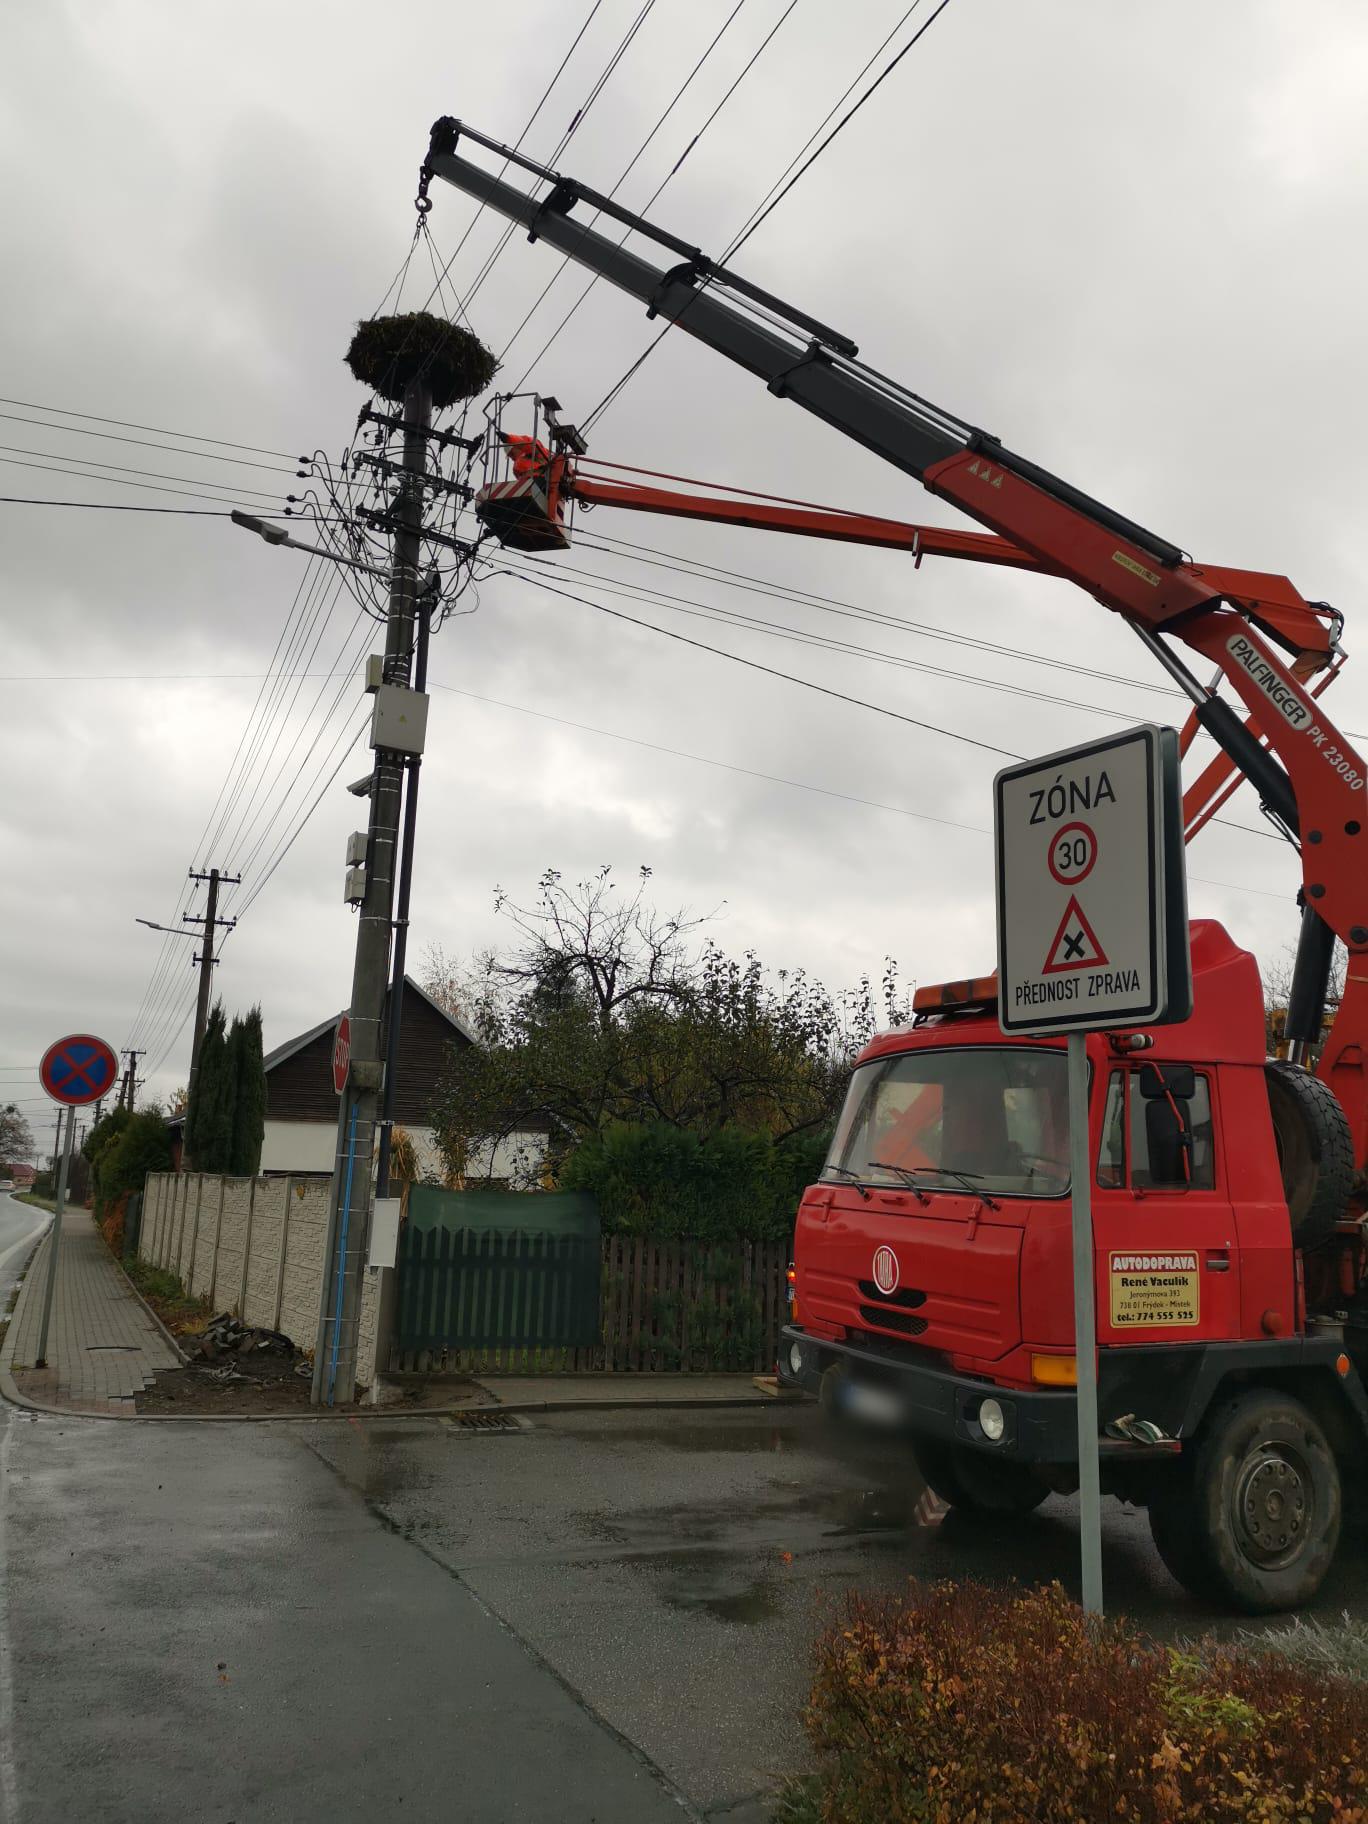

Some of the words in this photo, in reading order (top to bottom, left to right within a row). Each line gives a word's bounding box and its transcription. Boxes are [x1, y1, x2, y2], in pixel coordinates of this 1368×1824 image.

[1231, 638, 1306, 725] PALFINGER
[1306, 726, 1329, 748] PK
[1322, 746, 1364, 790] 23080
[1029, 771, 1117, 825] ZÓNA
[1058, 838, 1087, 870] 30
[1015, 977, 1081, 1006] PŘEDNOST
[1088, 969, 1140, 997] ZPRAVA
[1113, 1256, 1196, 1270] AUTODOPRAVA
[1157, 1311, 1174, 1319] 555
